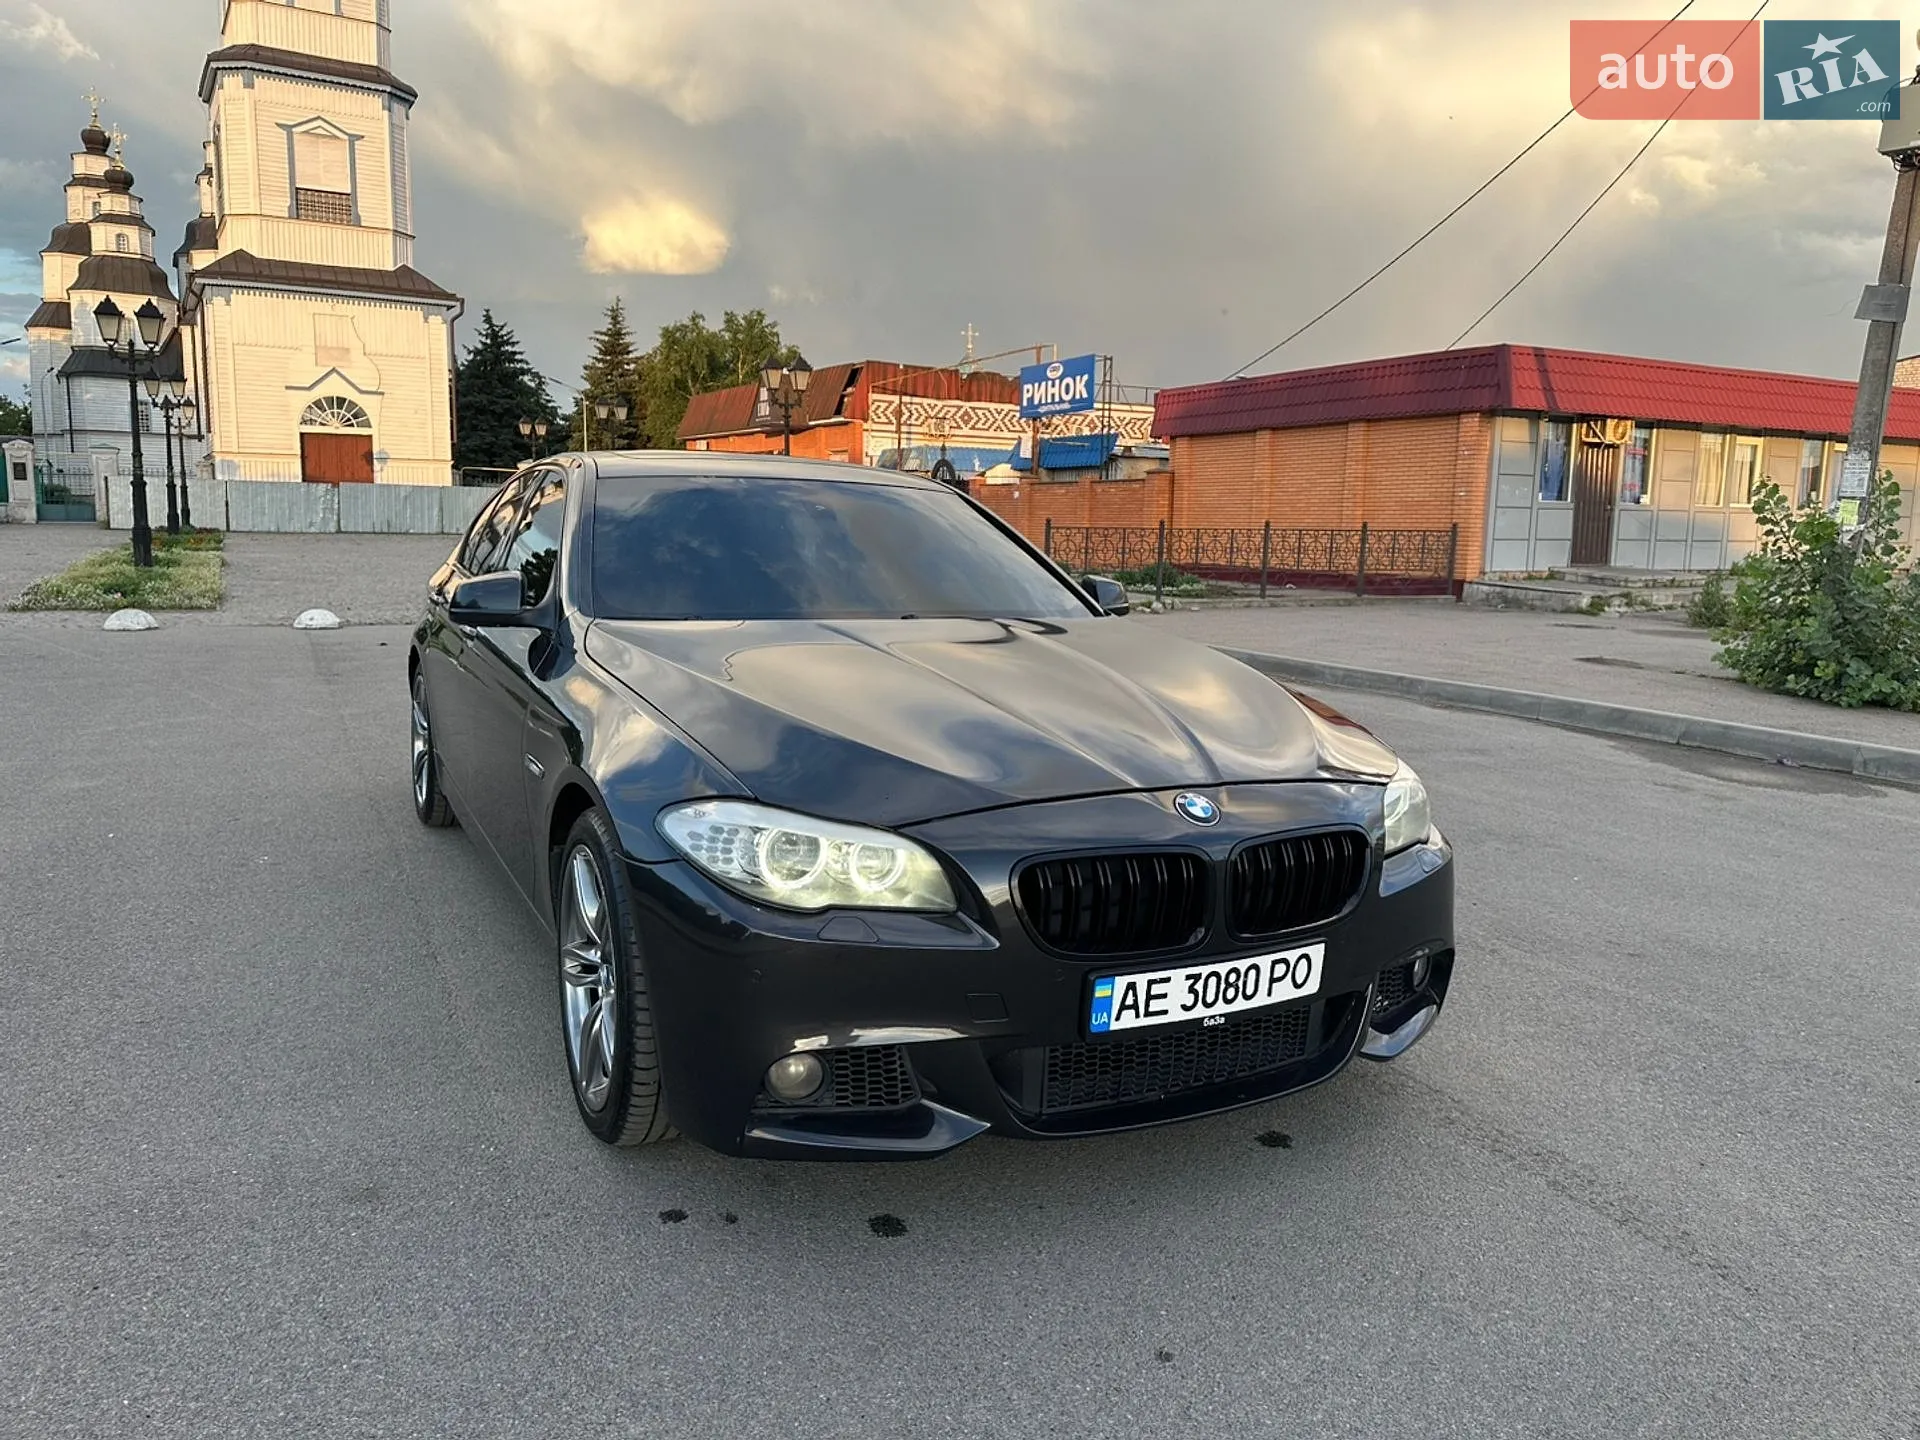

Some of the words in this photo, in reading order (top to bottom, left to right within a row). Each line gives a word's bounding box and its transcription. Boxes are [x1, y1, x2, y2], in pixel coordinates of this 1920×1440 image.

[1022, 374, 1089, 407] РИНОК
[1115, 976, 1172, 1022] AE
[1180, 963, 1260, 1012] 3080
[1267, 953, 1312, 998] PO
[1092, 1011, 1109, 1025] UA
